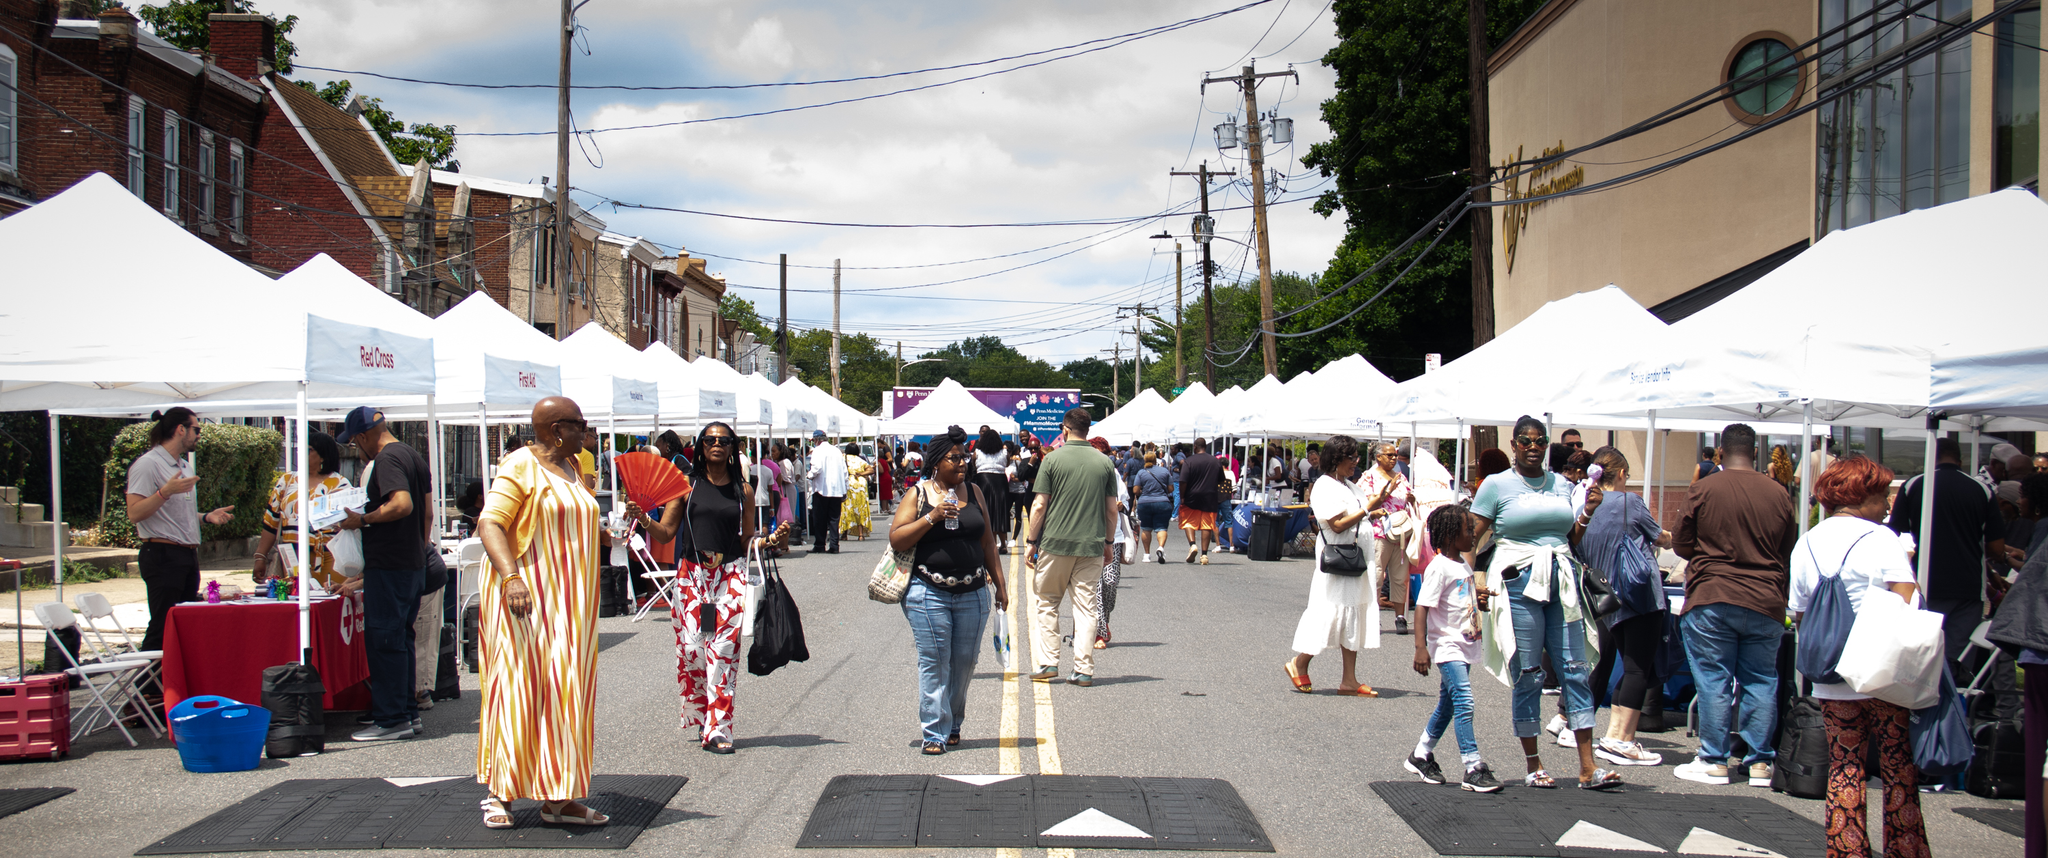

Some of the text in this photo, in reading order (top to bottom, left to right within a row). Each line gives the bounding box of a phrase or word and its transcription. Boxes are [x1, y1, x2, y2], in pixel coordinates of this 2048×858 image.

[360, 345, 395, 369] Red Cross
[518, 371, 537, 388] First Aid
[1661, 367, 1671, 382] Info
[1350, 422, 1388, 430] Informatn
[1356, 417, 1377, 425] Gener
